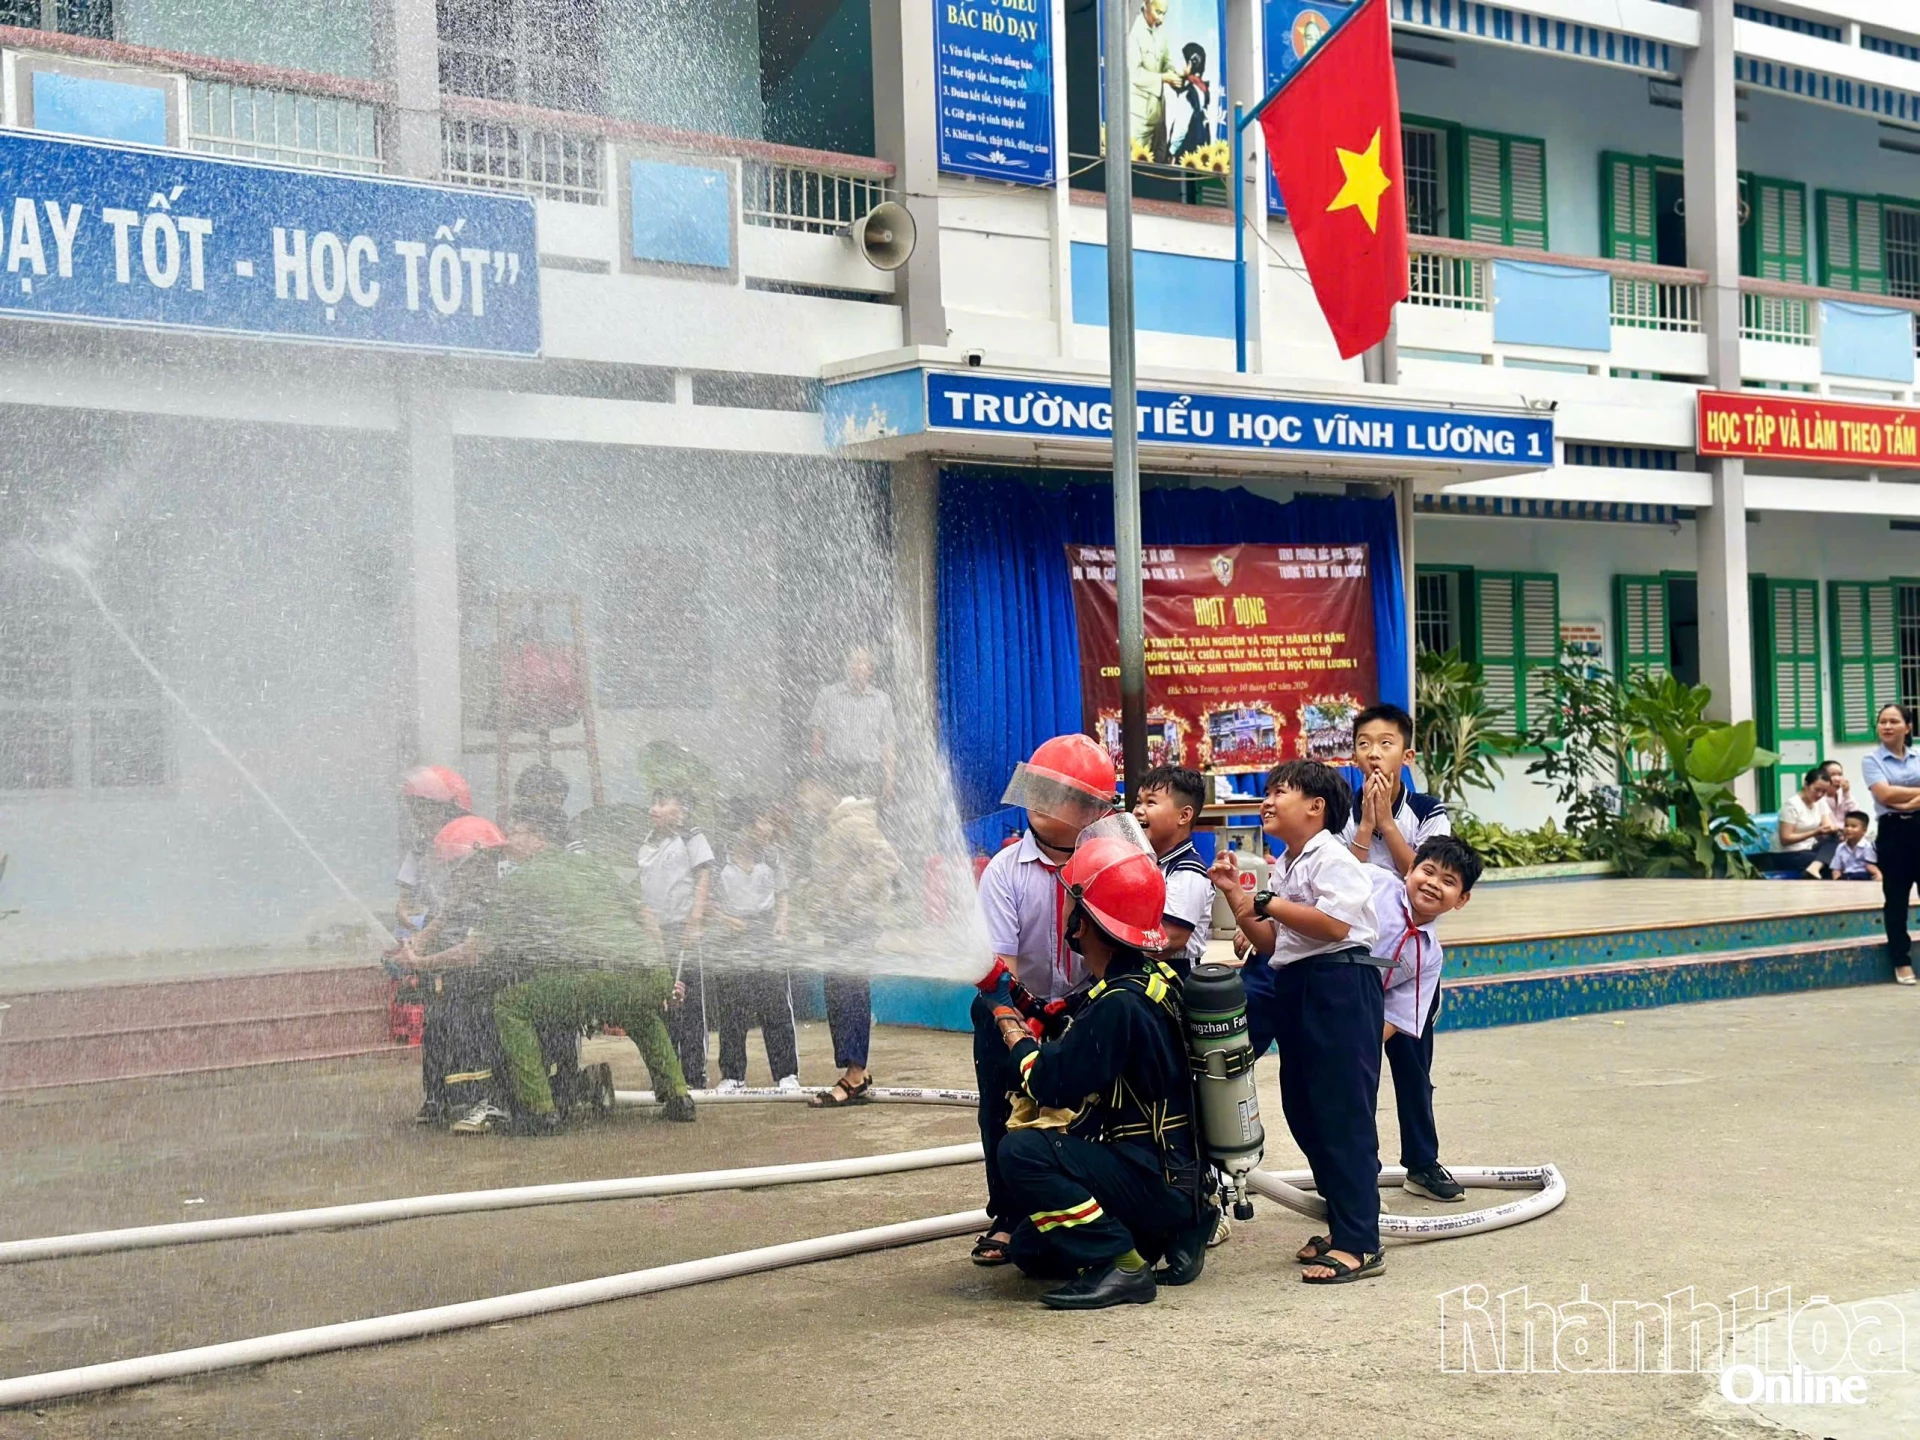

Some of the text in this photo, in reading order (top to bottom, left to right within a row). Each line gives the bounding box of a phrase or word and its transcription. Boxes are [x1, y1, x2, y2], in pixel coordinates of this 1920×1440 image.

[947, 2, 1038, 42] BÁC HỒ DẠY
[942, 43, 948, 54] 1.
[991, 54, 1003, 65] yêu
[942, 64, 949, 75] 2.
[950, 66, 964, 79] Học
[965, 69, 976, 82] tập
[1000, 76, 1017, 89] động
[943, 85, 949, 96] 3.
[970, 88, 980, 102] kết
[1003, 96, 1016, 110] luật
[1017, 97, 1026, 110] tốt
[944, 107, 951, 117] 4.
[977, 113, 985, 125] vệ
[986, 114, 1000, 126] sinh
[1001, 116, 1015, 130] thật
[1016, 116, 1025, 130] tốt
[945, 127, 951, 137] 5.
[952, 129, 975, 141] Khiêm
[989, 135, 1003, 148] thật
[0, 197, 83, 294] ẠY
[102, 186, 213, 291] TỐT
[273, 227, 381, 320] HỌC
[943, 391, 1543, 457] TRƯỜNG TIỂU HỌC VĨNH LƯƠNG 1
[1707, 406, 1917, 456] HỌC TẬP VÀ LÀM THEO TẤM
[1193, 593, 1268, 630] HOẠT ĐỘNG
[1189, 635, 1210, 647] TRẢI
[1212, 634, 1245, 647] NGHIỆM
[1247, 634, 1259, 645] VÀ
[1260, 635, 1284, 646] THỰC
[1286, 633, 1310, 644] HÀNH
[1324, 632, 1346, 643] NĂNG
[1144, 649, 1169, 661] HÒNG
[1198, 648, 1221, 659] CHỮA
[1223, 647, 1245, 658] CHÁY
[1247, 647, 1259, 658] VÀ
[1261, 646, 1277, 658] CỨU
[1302, 645, 1318, 656] CỨU
[1320, 644, 1332, 657] HỘ
[1101, 658, 1357, 677] CHO VIÊN VÀ HỌC SINH TRƯỜNG TIỂU HỌC VĨNH LƯƠNG 1
[1183, 685, 1198, 694] Nha
[1222, 685, 1238, 695] ngày
[1249, 683, 1267, 693] tháng
[1267, 682, 1276, 690] 02
[1292, 681, 1308, 690] 2026
[1190, 1022, 1229, 1035] ngzhan
